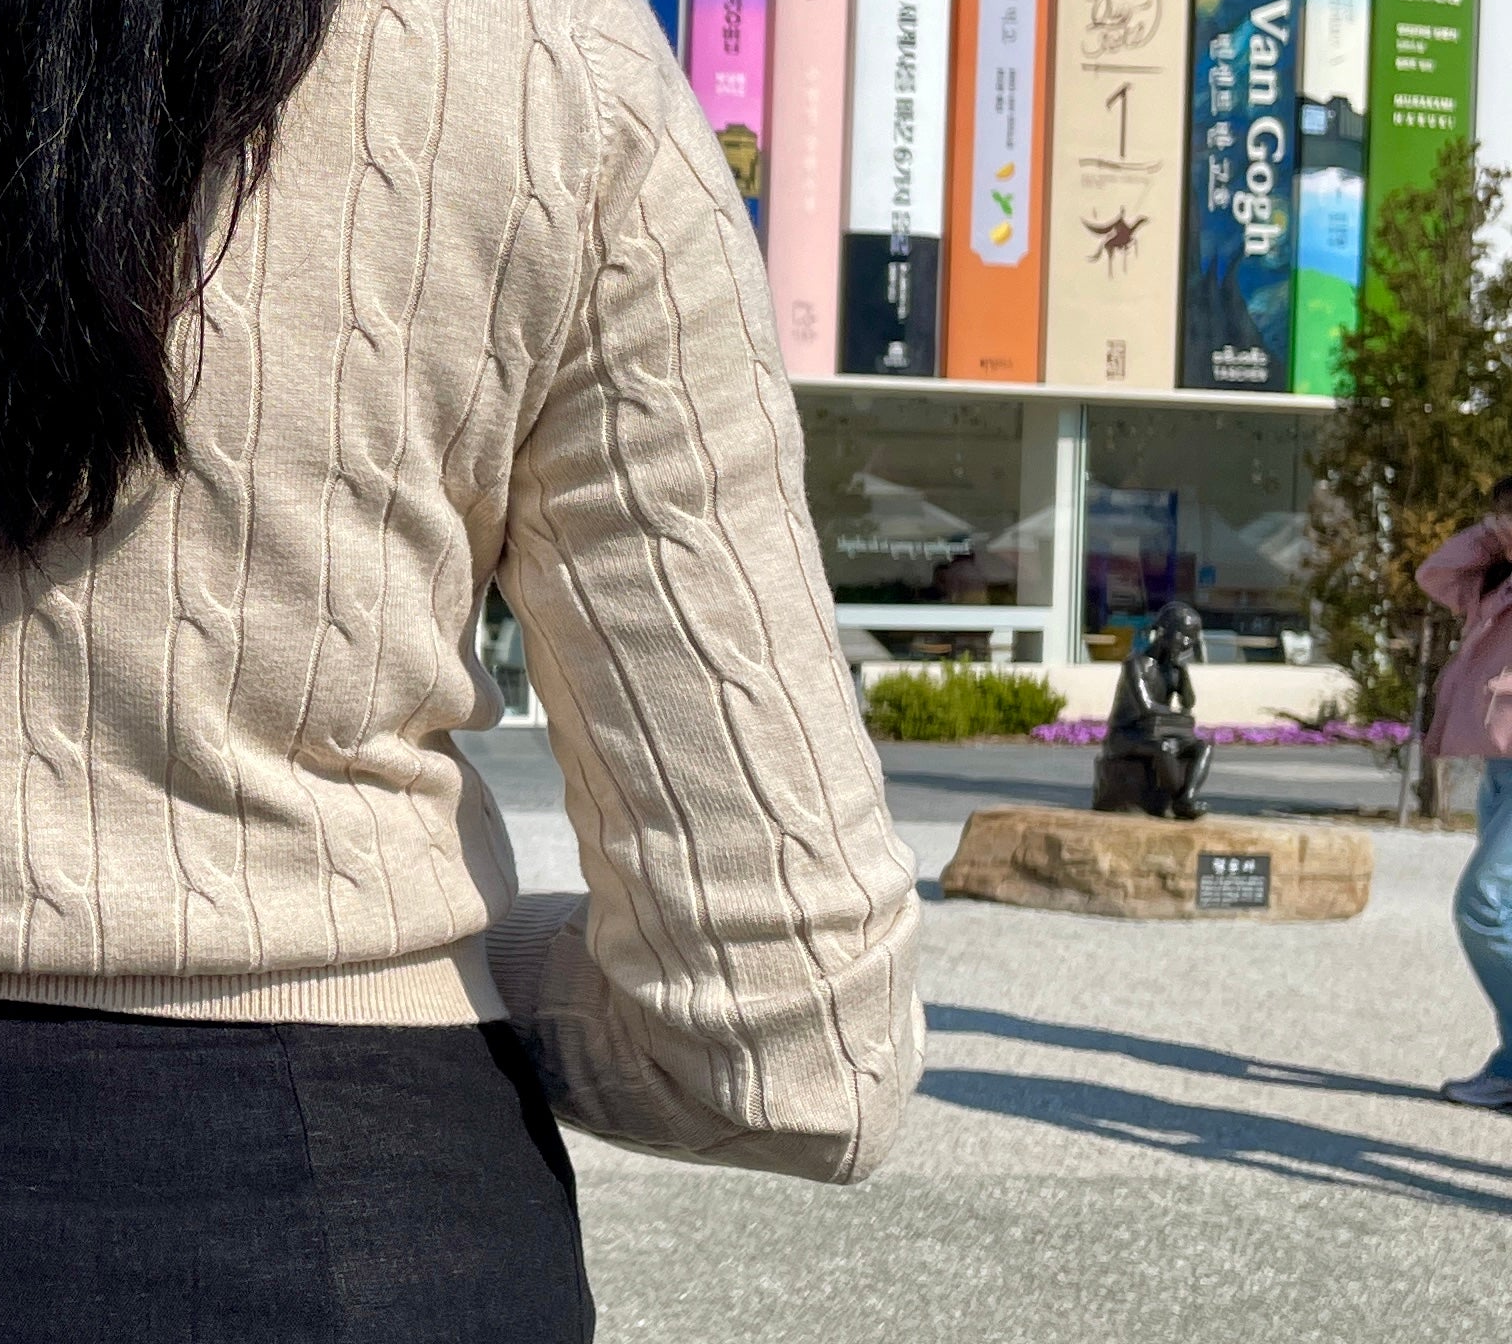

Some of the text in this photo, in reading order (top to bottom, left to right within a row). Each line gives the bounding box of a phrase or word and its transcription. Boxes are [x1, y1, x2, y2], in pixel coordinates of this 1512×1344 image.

[1206, 33, 1238, 212] 빈센트 반 고흐
[1232, 115, 1286, 257] Gogh
